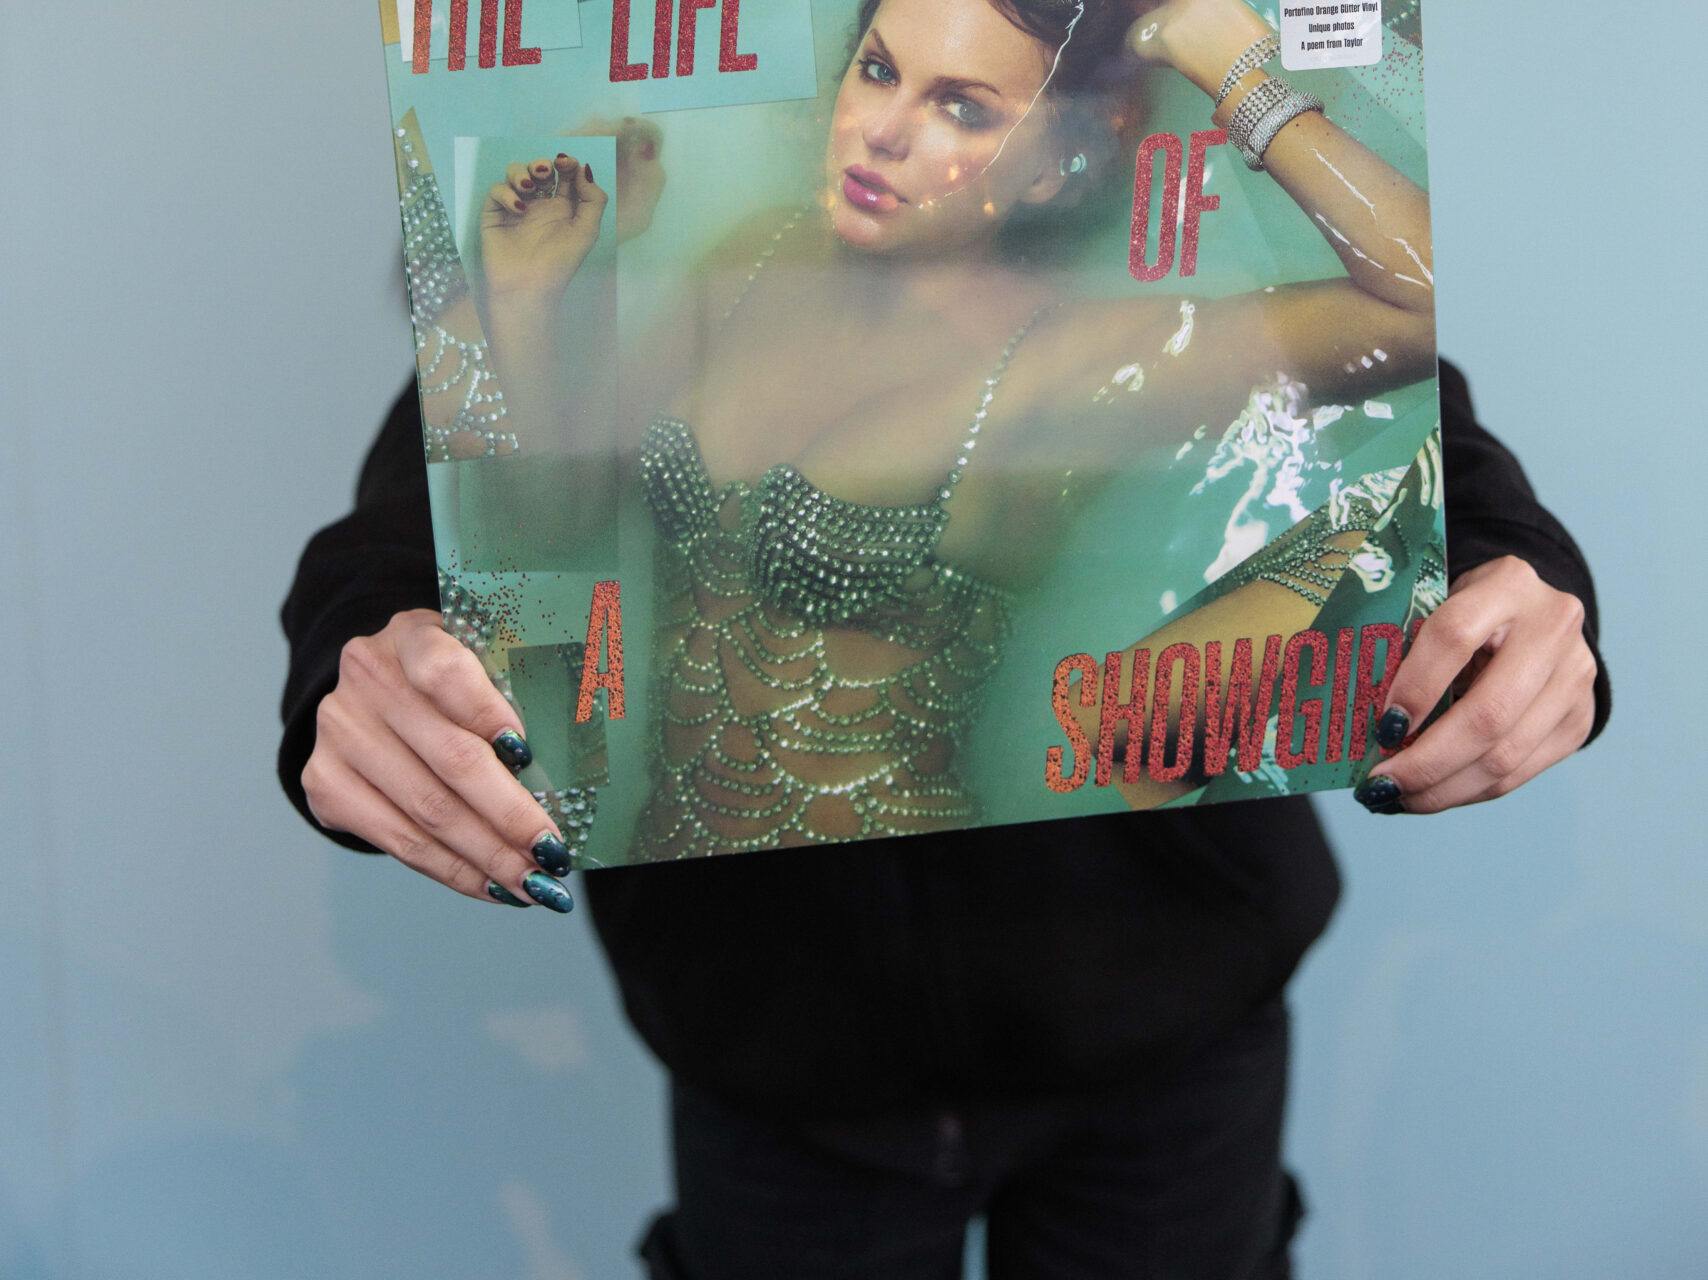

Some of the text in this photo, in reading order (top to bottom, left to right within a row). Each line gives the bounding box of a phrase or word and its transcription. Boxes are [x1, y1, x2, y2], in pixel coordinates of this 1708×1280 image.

[1284, 2, 1378, 17] Portofino Orange Glitter Vinyl
[1308, 22, 1354, 33] Unique photos
[1301, 38, 1363, 52] A poem from Taylor
[1128, 128, 1229, 283] OF
[575, 580, 626, 723] A
